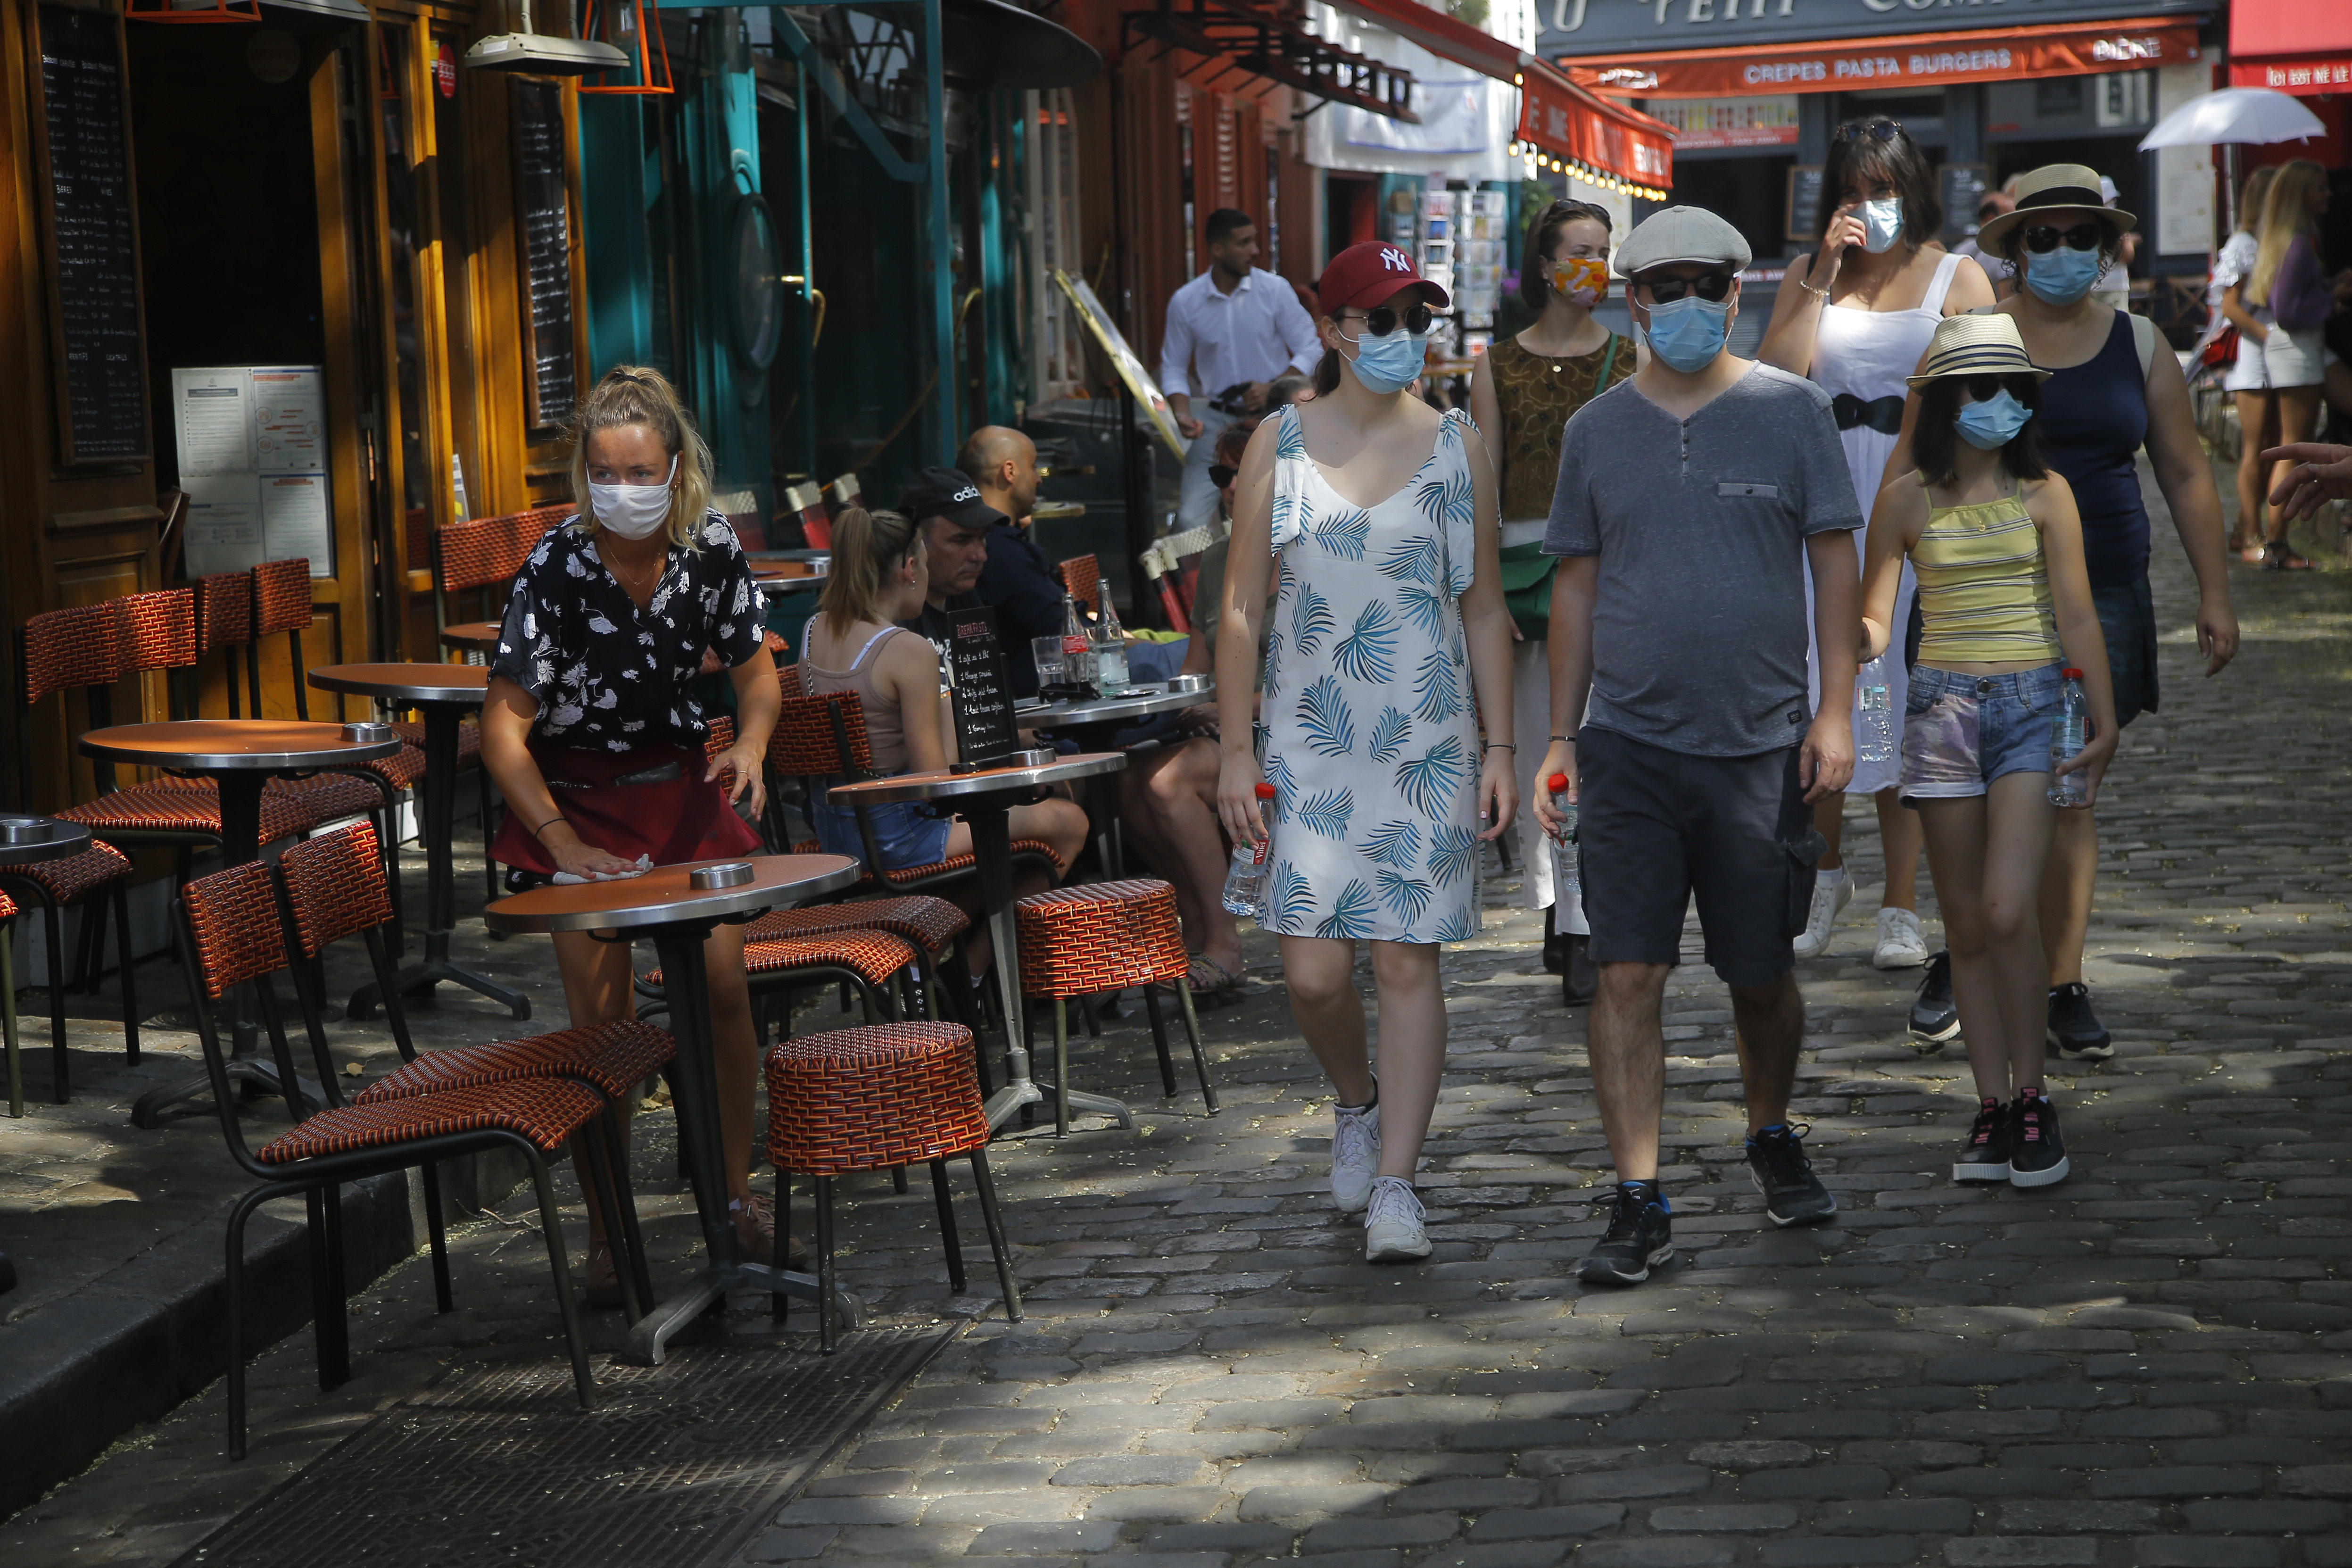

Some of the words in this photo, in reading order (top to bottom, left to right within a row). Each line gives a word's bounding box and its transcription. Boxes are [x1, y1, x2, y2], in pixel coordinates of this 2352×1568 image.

[1745, 60, 1827, 83] CREPES
[1834, 57, 1900, 79] PASTA
[1908, 48, 2011, 74] BURGERS
[1379, 247, 1411, 273] NY
[1256, 842, 1266, 858] Vittel
